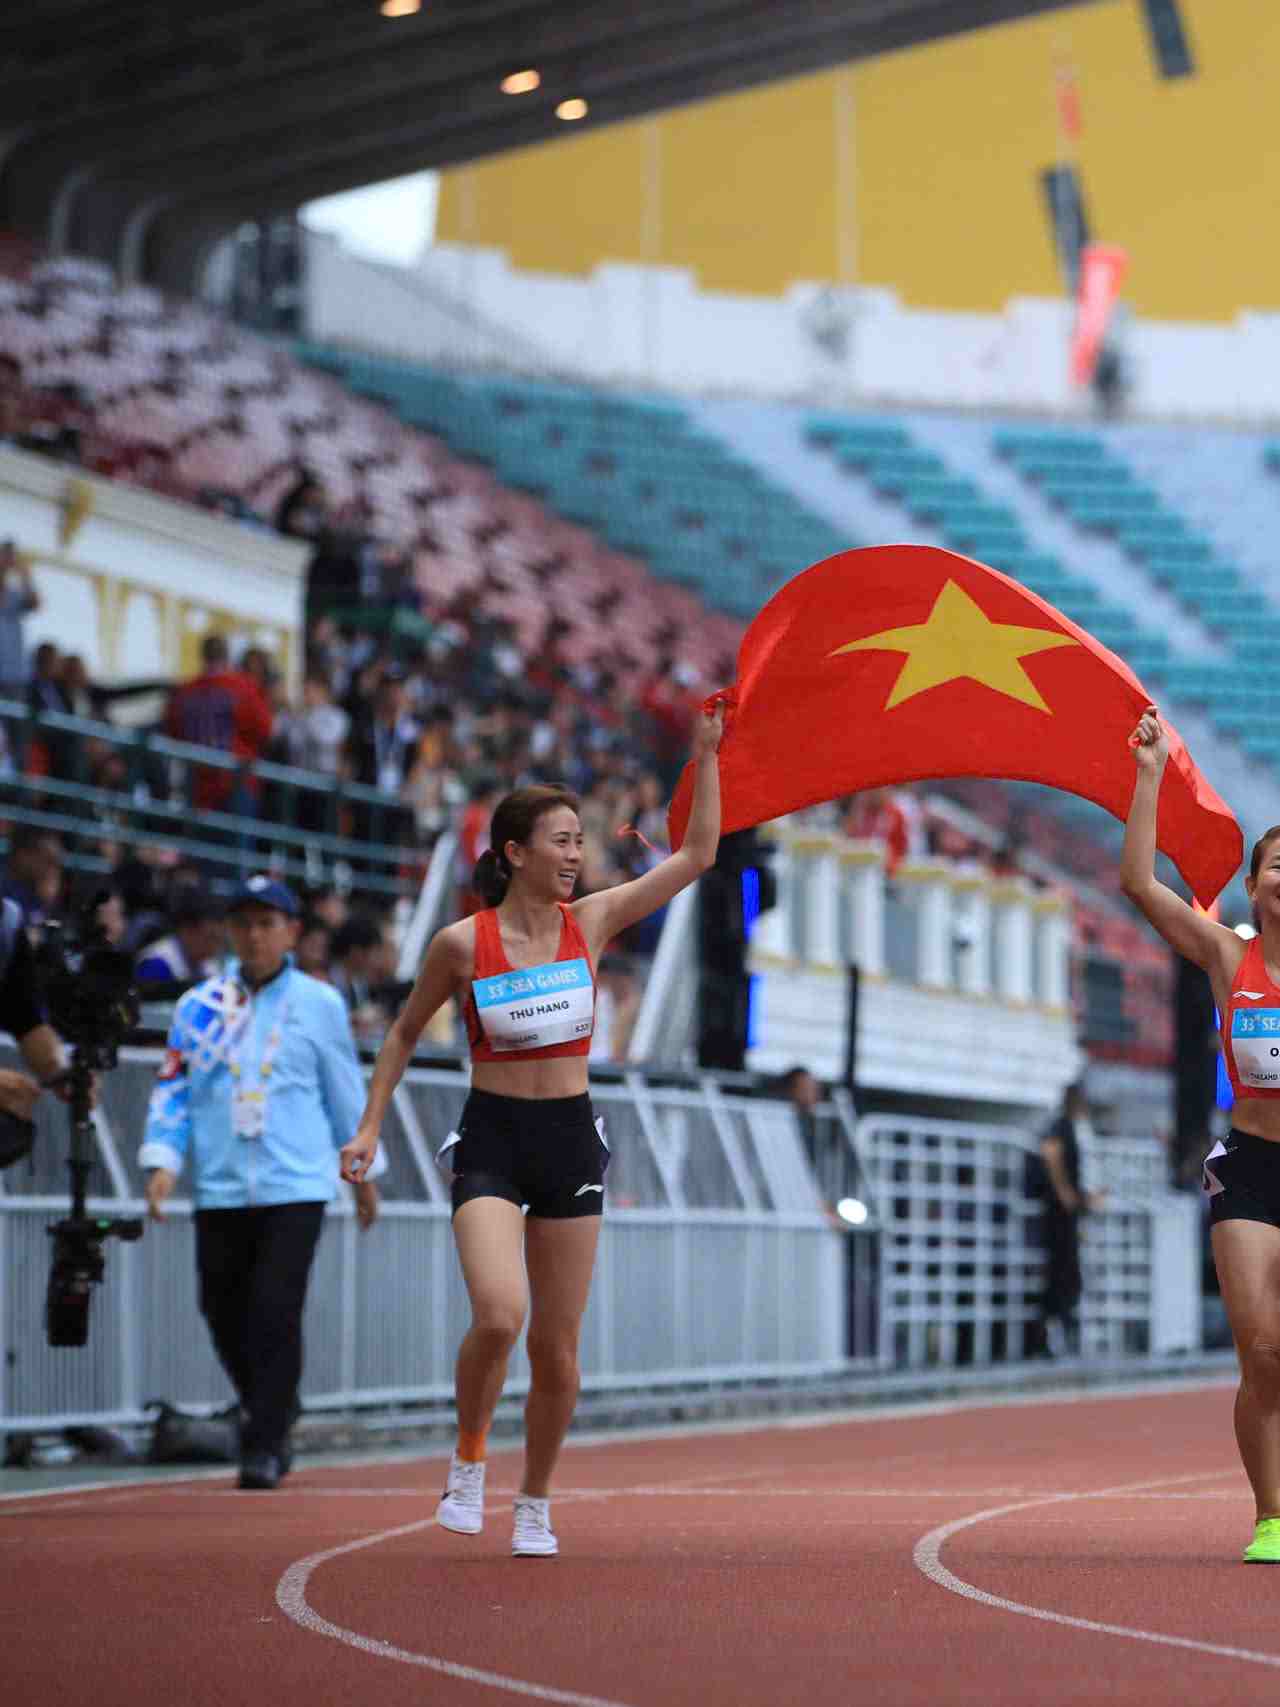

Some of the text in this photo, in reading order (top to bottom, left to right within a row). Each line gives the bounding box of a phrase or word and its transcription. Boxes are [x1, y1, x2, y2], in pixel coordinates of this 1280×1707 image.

[511, 977, 535, 994] SEA
[537, 969, 577, 987] GAMES
[509, 1000, 569, 1021] THU HANG
